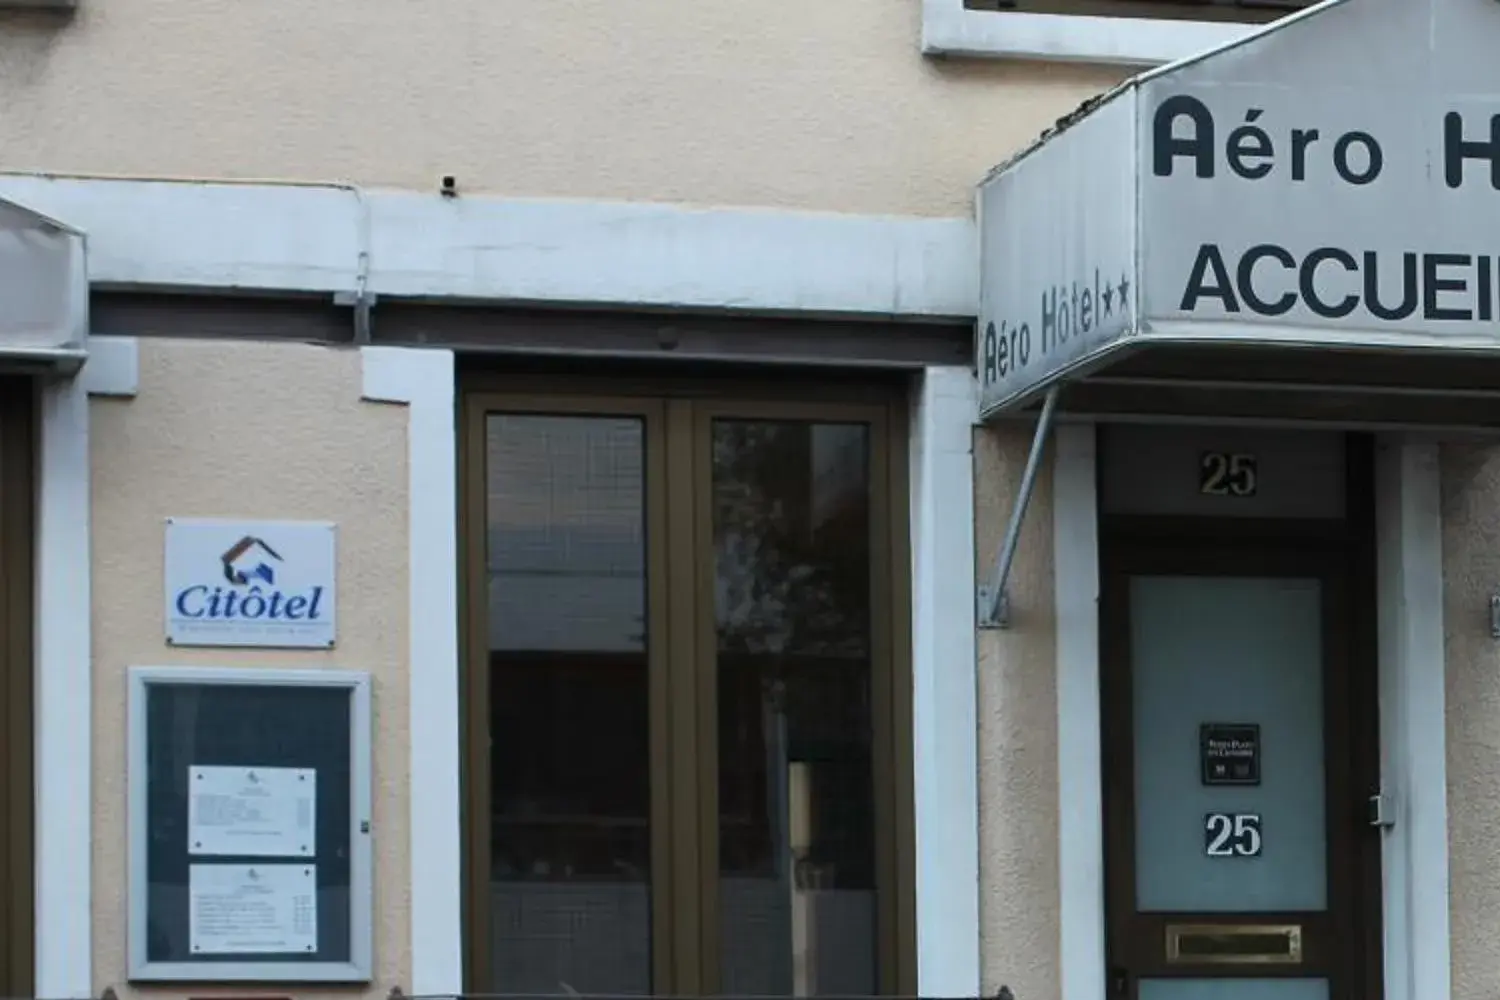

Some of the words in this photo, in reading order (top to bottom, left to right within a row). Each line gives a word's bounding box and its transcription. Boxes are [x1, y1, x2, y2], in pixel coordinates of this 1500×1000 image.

[1152, 95, 1384, 185] Aéro
[985, 320, 1031, 386] Aéro
[1042, 266, 1099, 355] Hôtel
[1202, 453, 1257, 495] 25
[176, 585, 323, 620] Citôtel
[1206, 814, 1262, 857] 25
